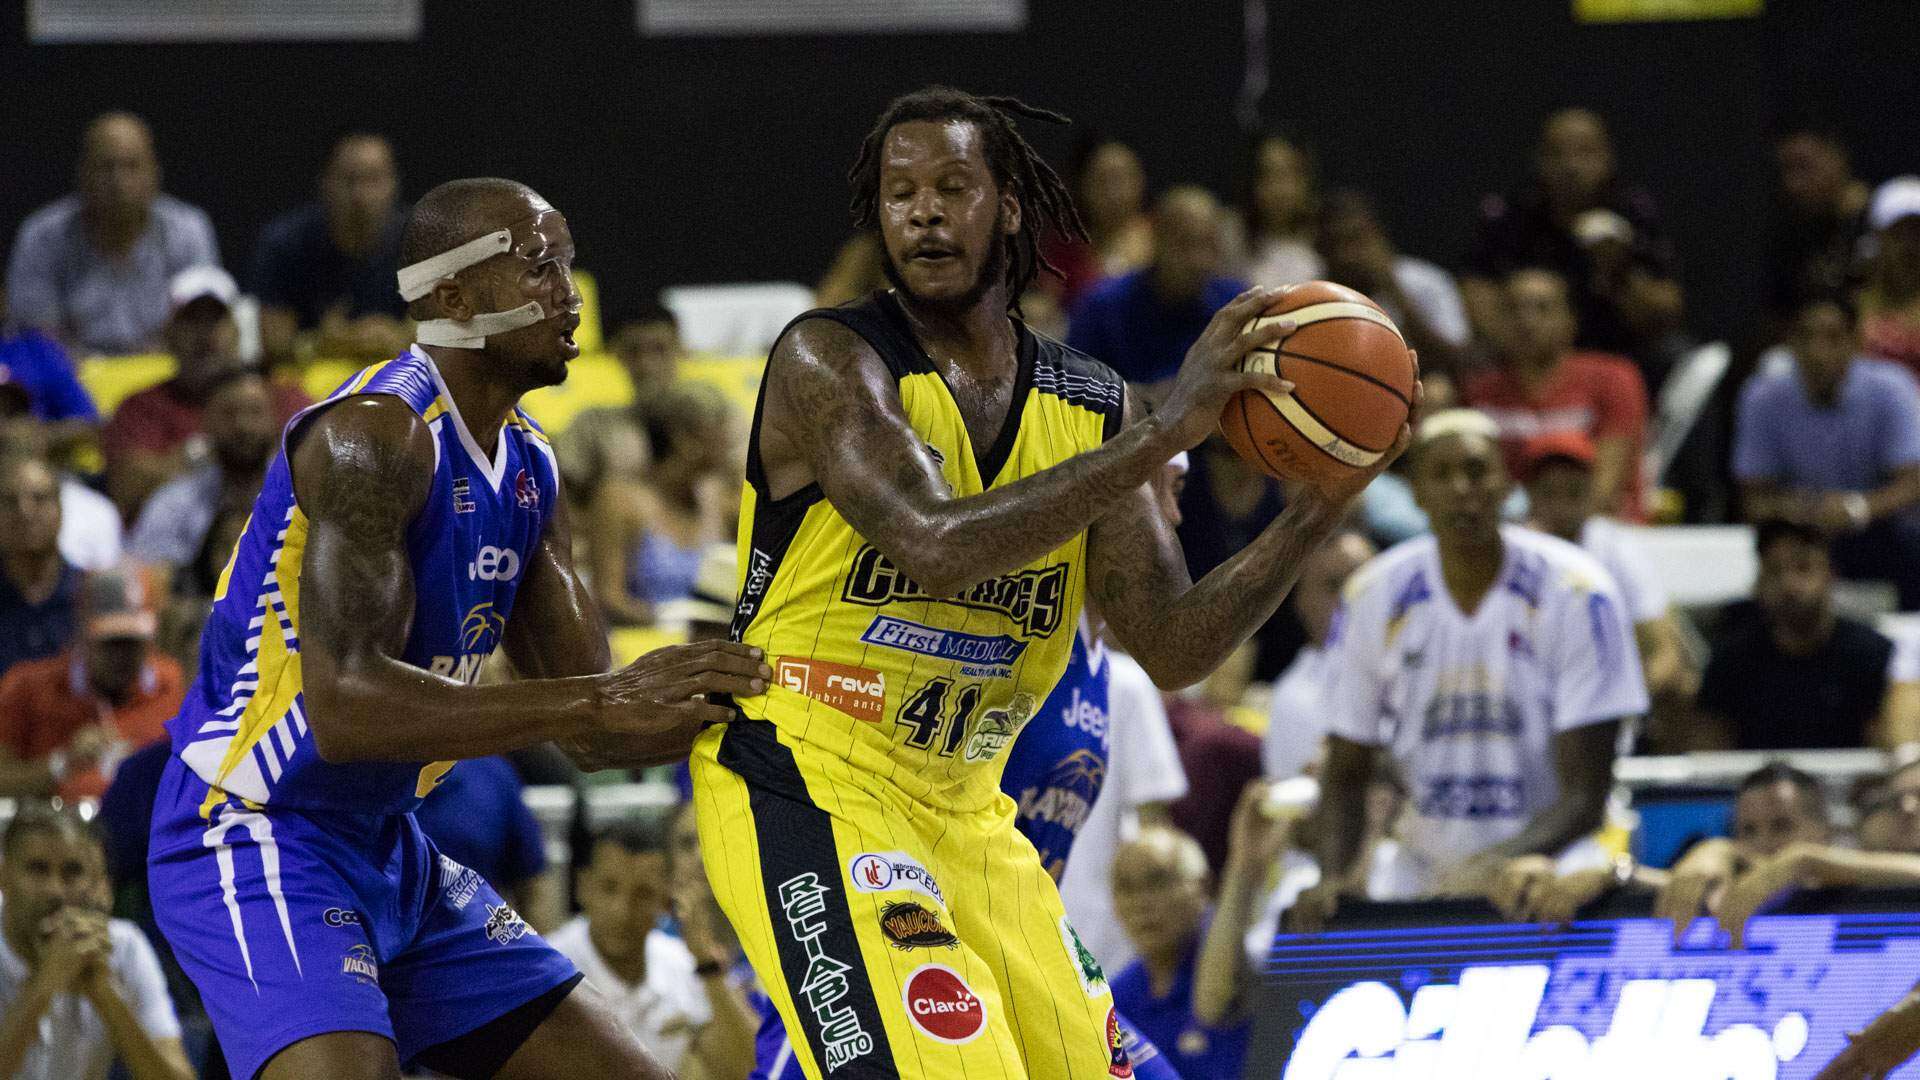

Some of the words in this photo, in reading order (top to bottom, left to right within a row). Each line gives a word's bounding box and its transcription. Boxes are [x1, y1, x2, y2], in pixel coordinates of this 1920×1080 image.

[876, 622, 938, 651] First
[895, 675, 982, 758] 41
[779, 872, 862, 1044] RELIABLE
[914, 997, 970, 1015] Claro
[826, 1031, 873, 1074] AUTO
